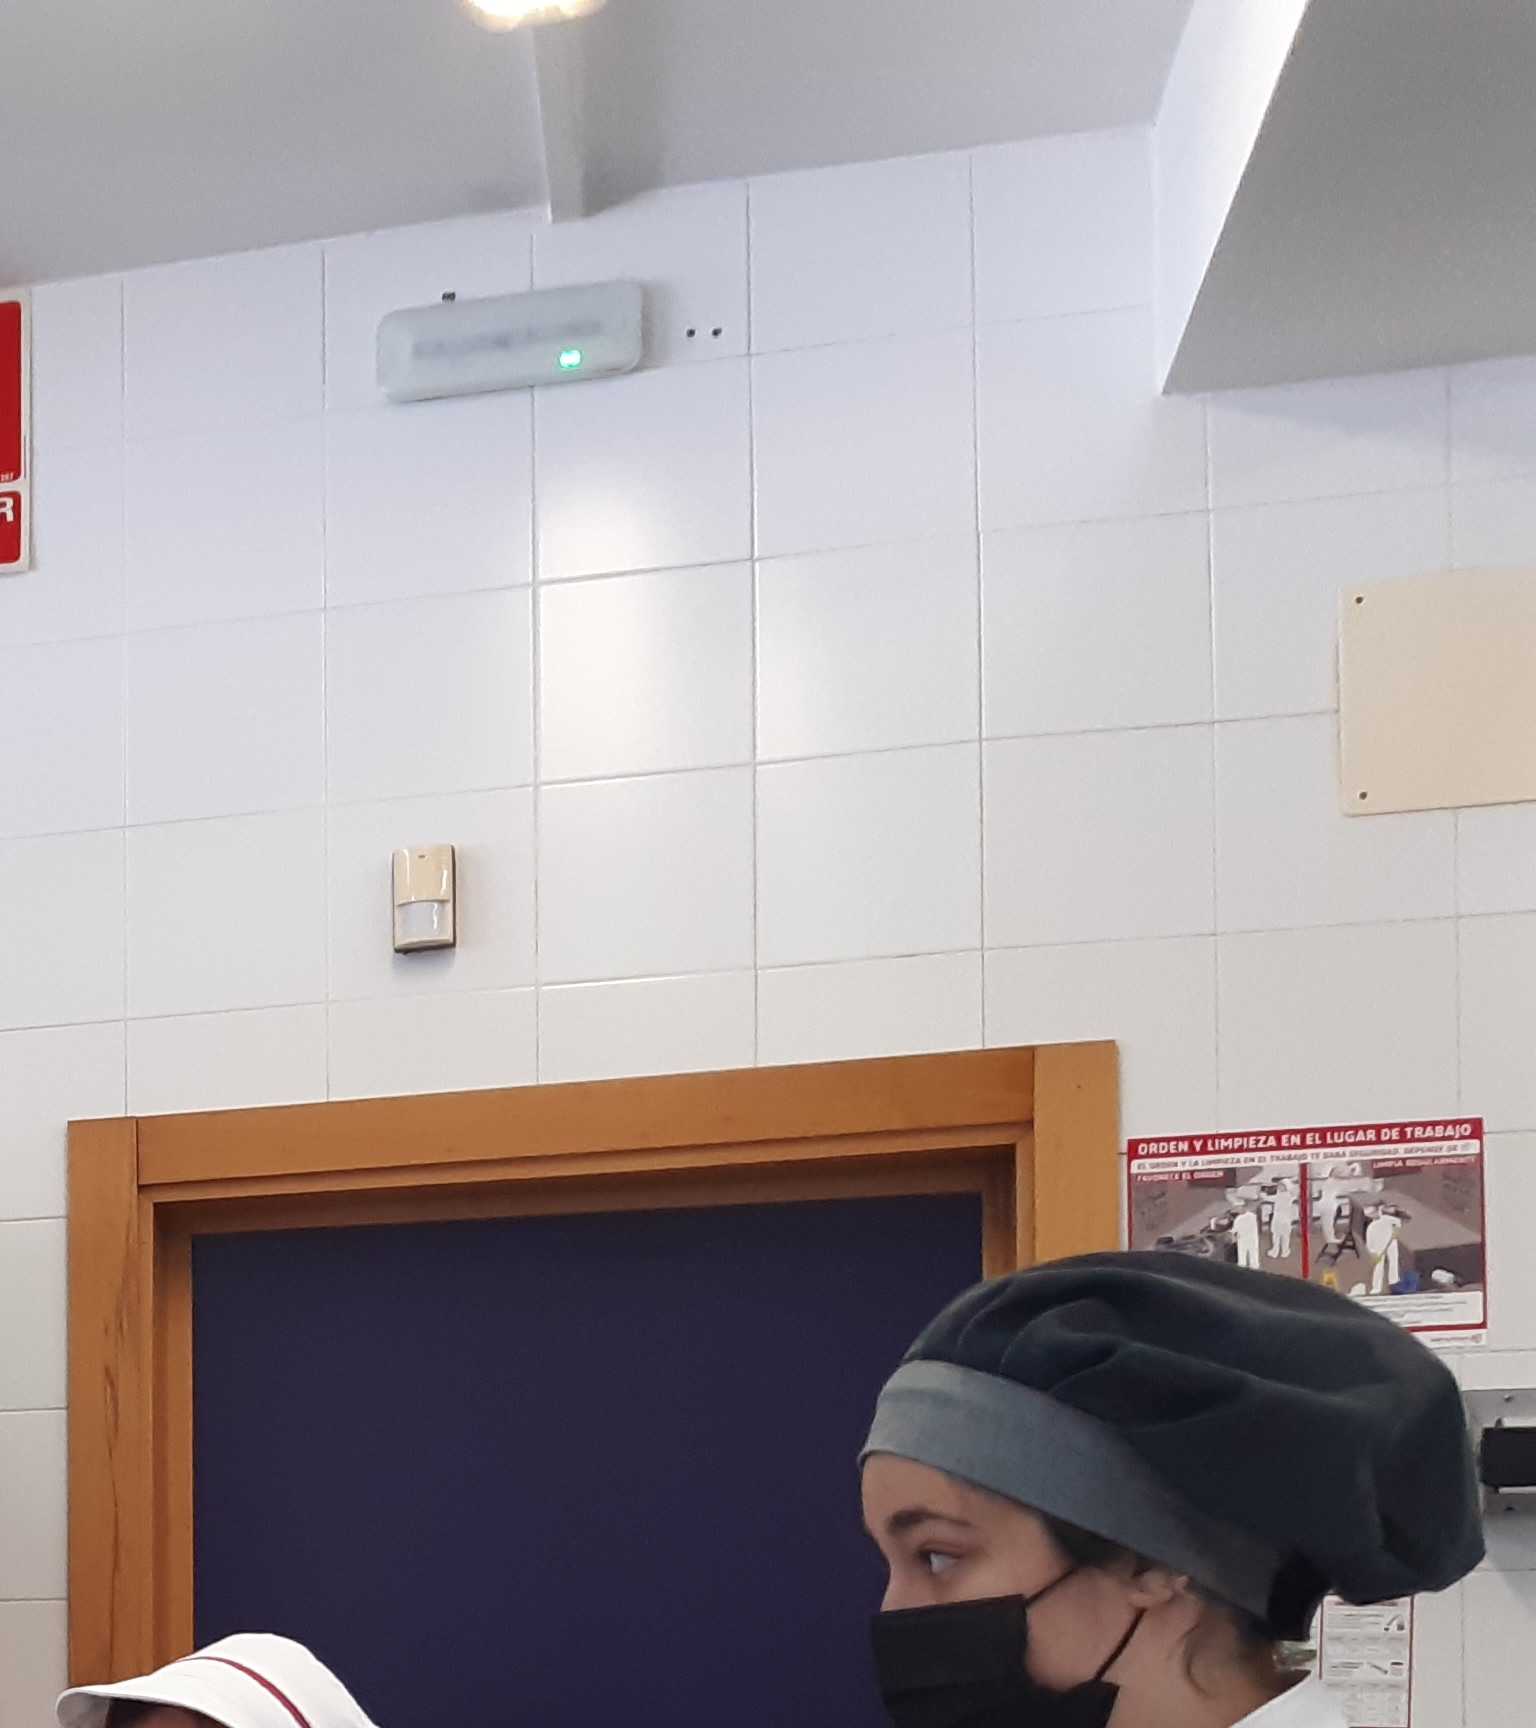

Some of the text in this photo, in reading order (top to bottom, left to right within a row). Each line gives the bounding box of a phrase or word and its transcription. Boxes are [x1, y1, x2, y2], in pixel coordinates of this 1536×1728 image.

[1137, 1124, 1472, 1156] ORDEN Y LIMPIEZA EN EL LUGAR DE TRABAJO
